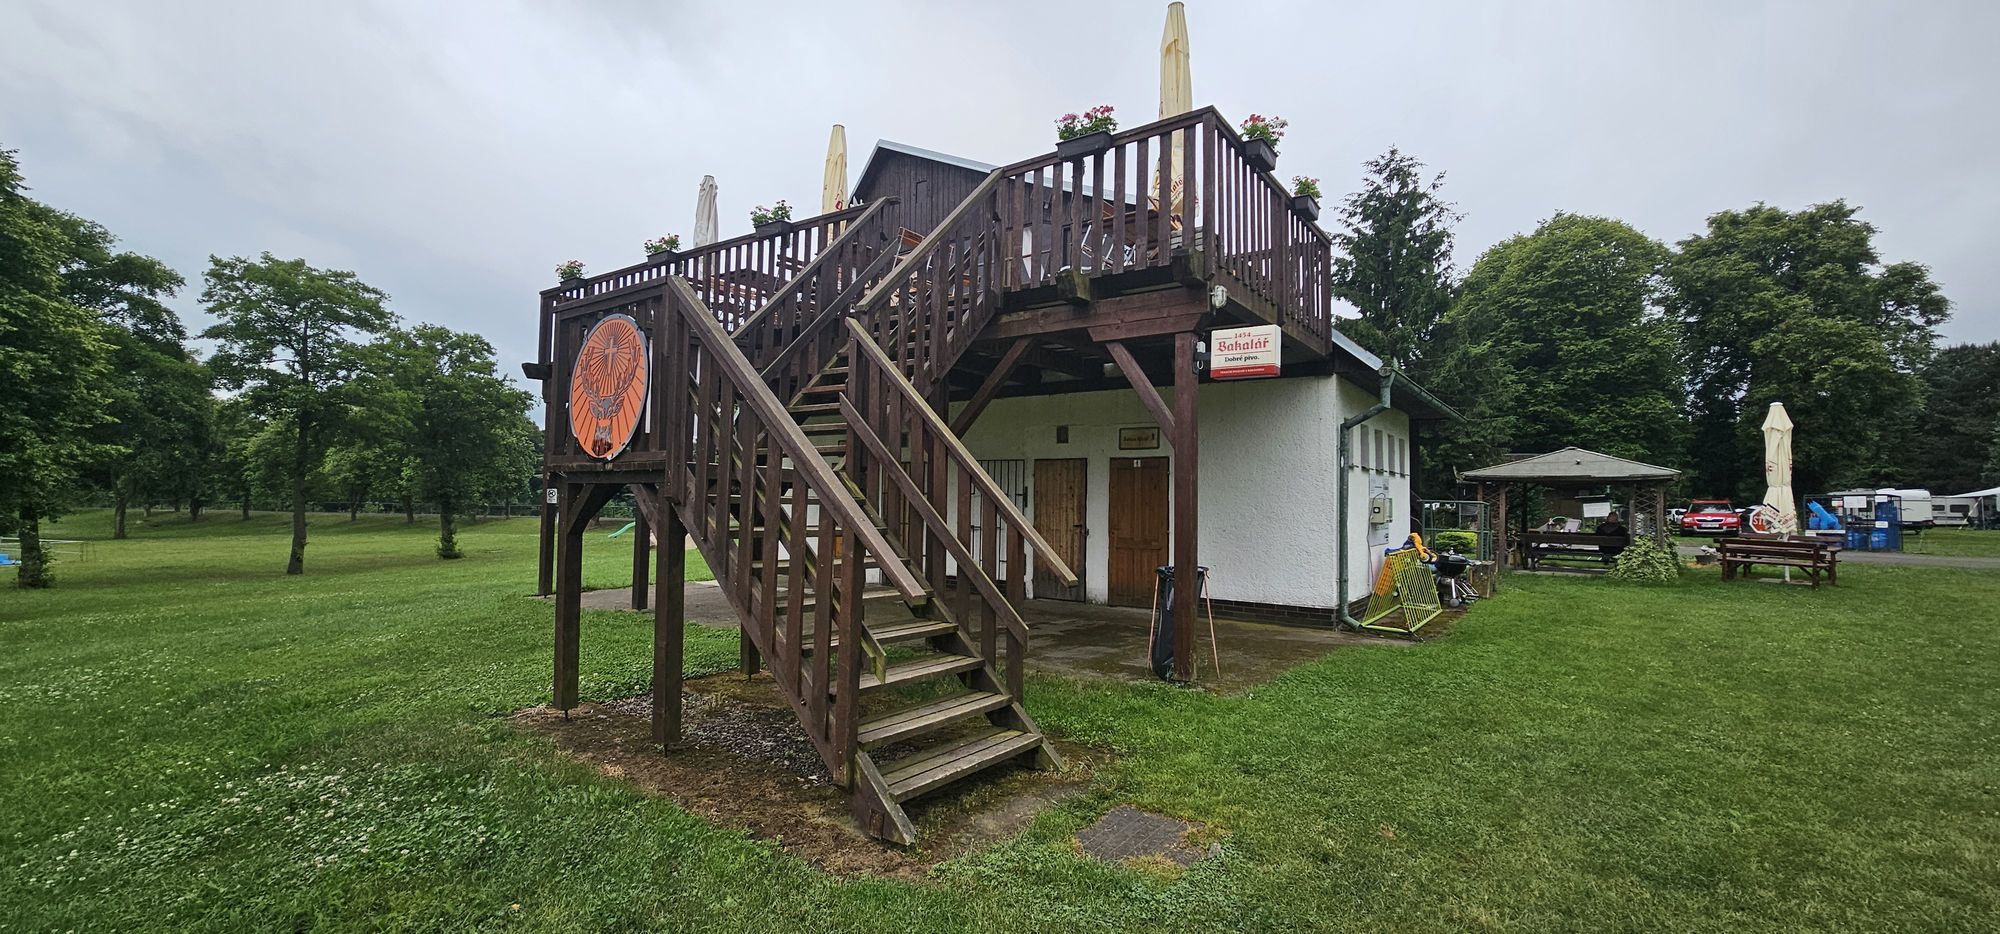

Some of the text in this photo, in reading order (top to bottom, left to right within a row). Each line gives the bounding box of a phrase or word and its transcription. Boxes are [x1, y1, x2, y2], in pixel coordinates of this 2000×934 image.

[1217, 338, 1269, 352] Bakalář
[1224, 354, 1260, 363] Dobré pivo.
